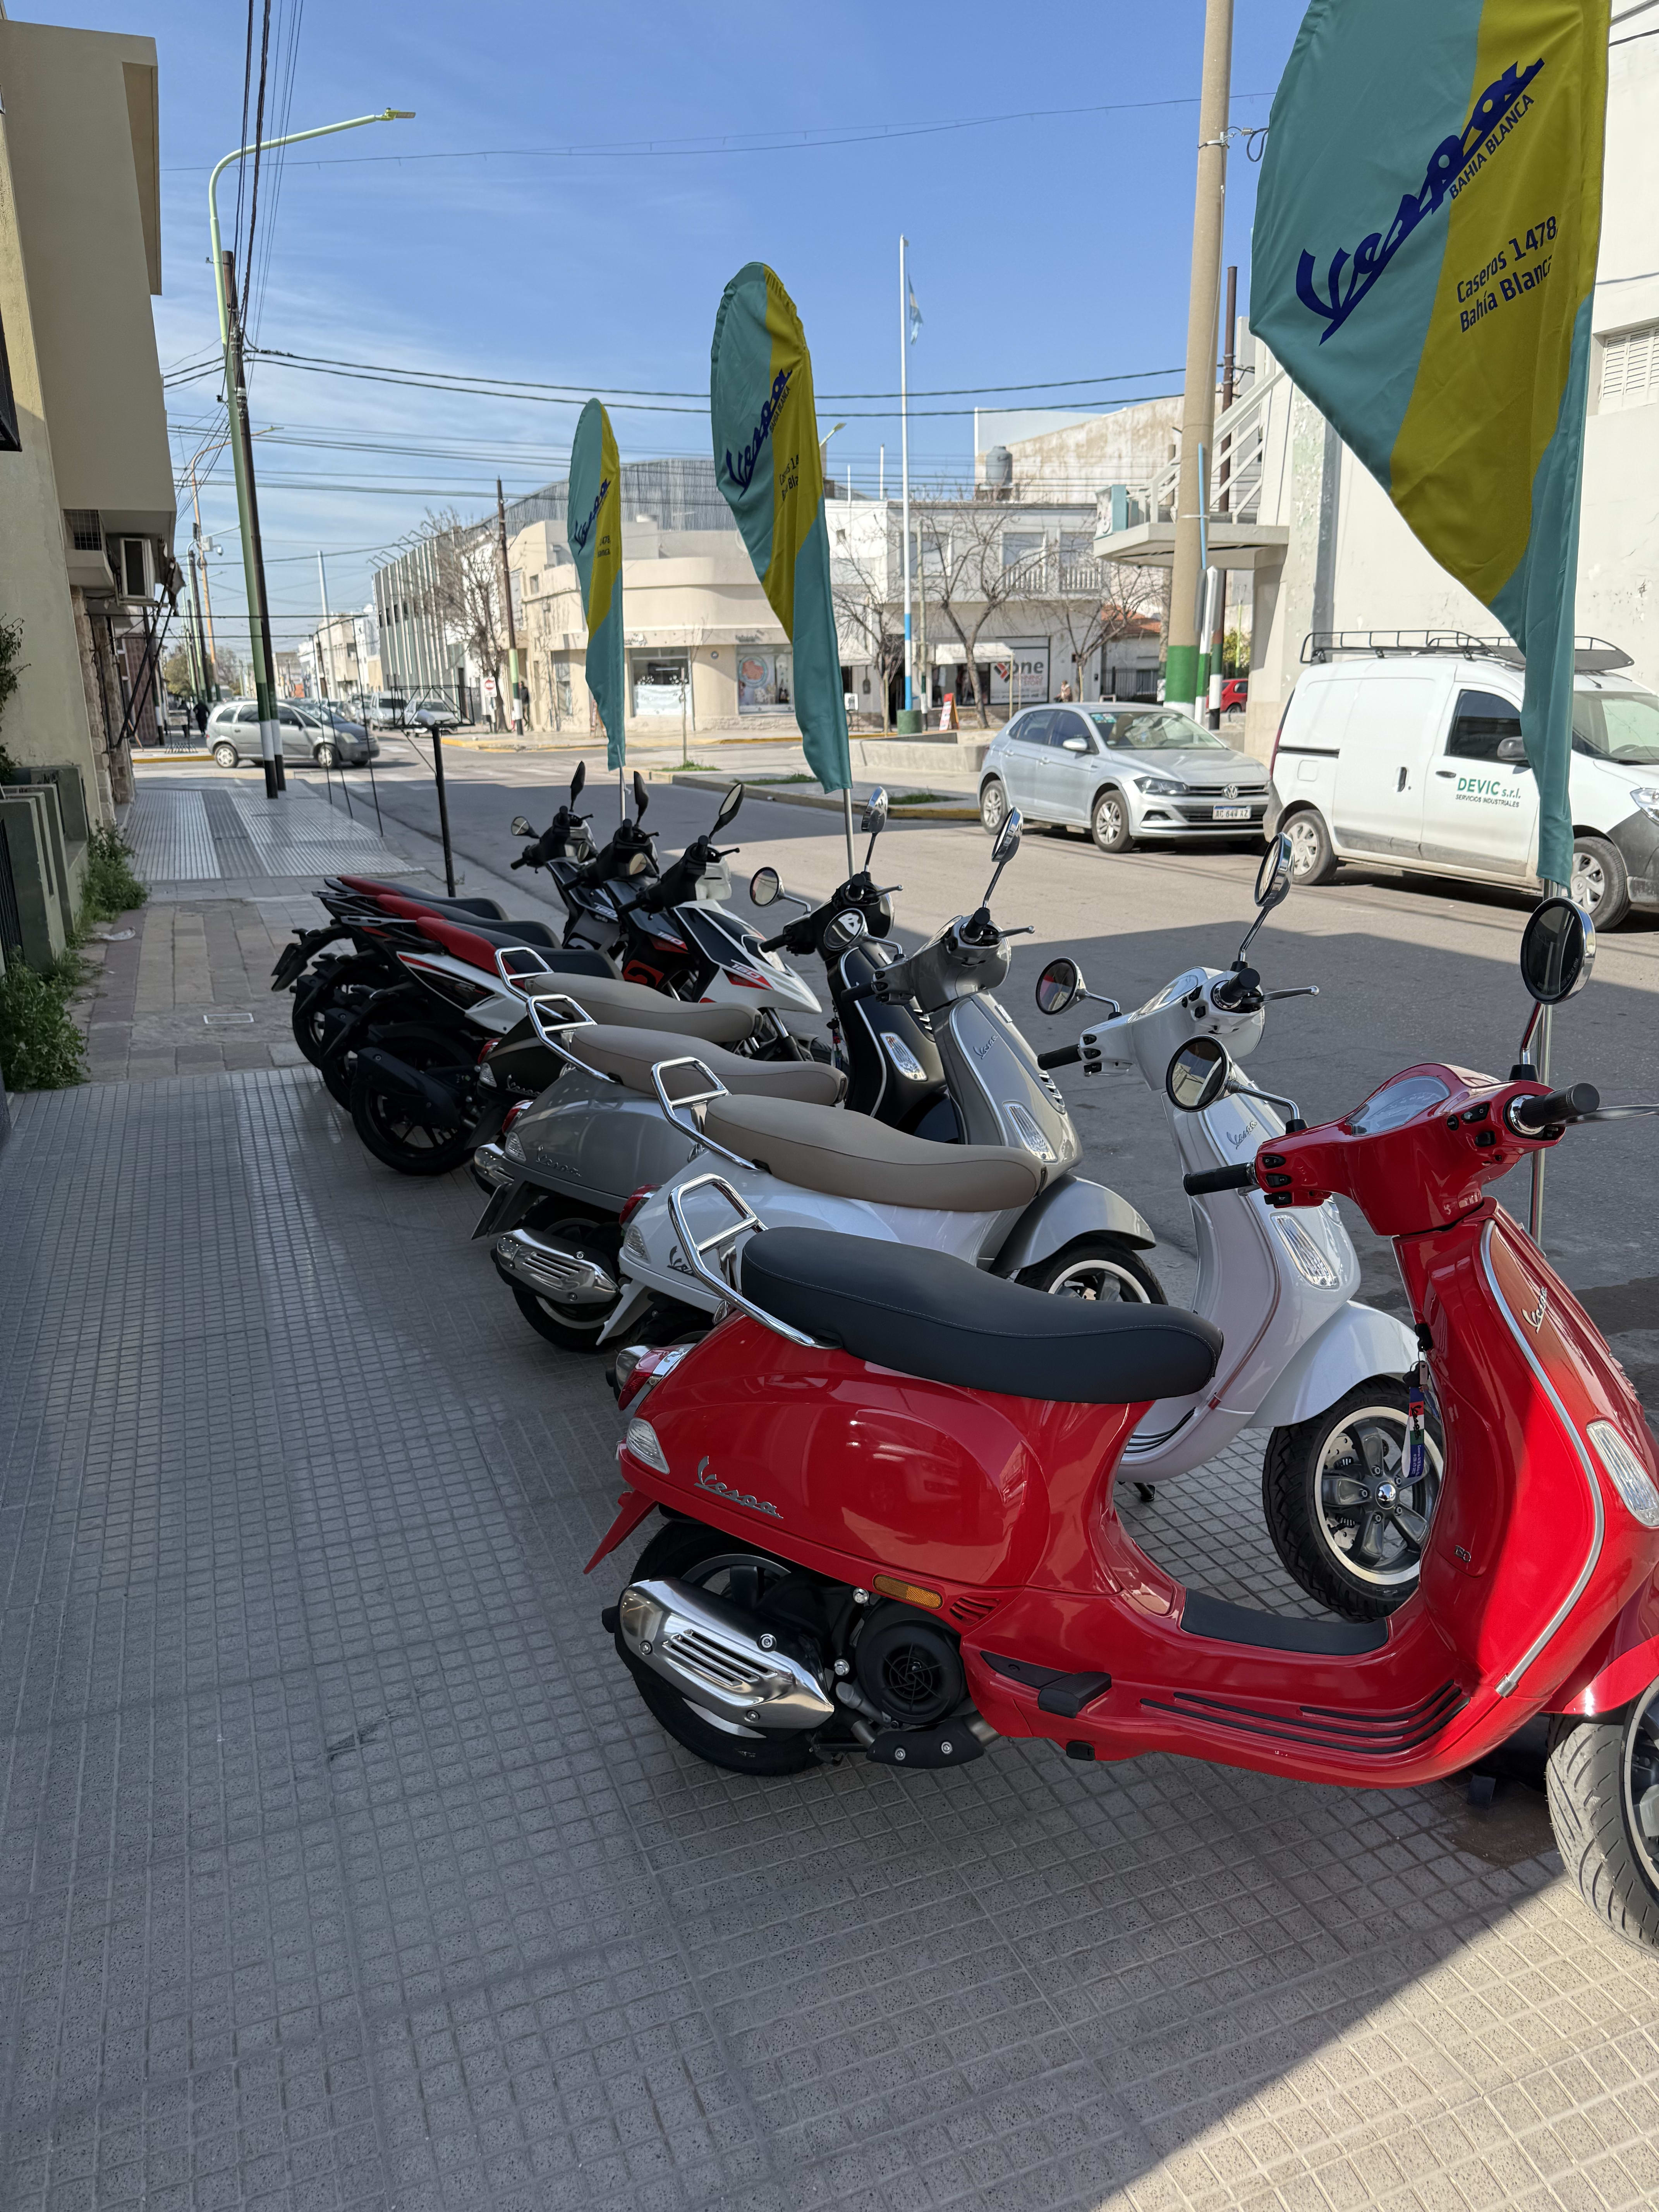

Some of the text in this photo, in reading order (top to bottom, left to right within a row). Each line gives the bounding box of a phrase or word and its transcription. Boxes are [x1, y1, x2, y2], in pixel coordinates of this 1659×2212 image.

[1449, 94, 1534, 200] BAHIA BLANCA
[1296, 58, 1545, 346] Vespa
[1457, 216, 1558, 303] Caseros 1478
[1460, 290, 1498, 333] Bahía
[726, 368, 792, 501] Vespa
[574, 477, 611, 555] Vespa
[1456, 793, 1520, 808] SERVICIOS INDUSTRIALES
[1457, 778, 1521, 799] DEVIC s.r.l.
[973, 1035, 998, 1060] Vespa
[1226, 1121, 1257, 1150] Vespa
[536, 1144, 582, 1177] Vespa
[1521, 1286, 1547, 1334] Vespa
[1410, 1405, 1422, 1440] Vespa
[694, 1456, 784, 1519] Vespa
